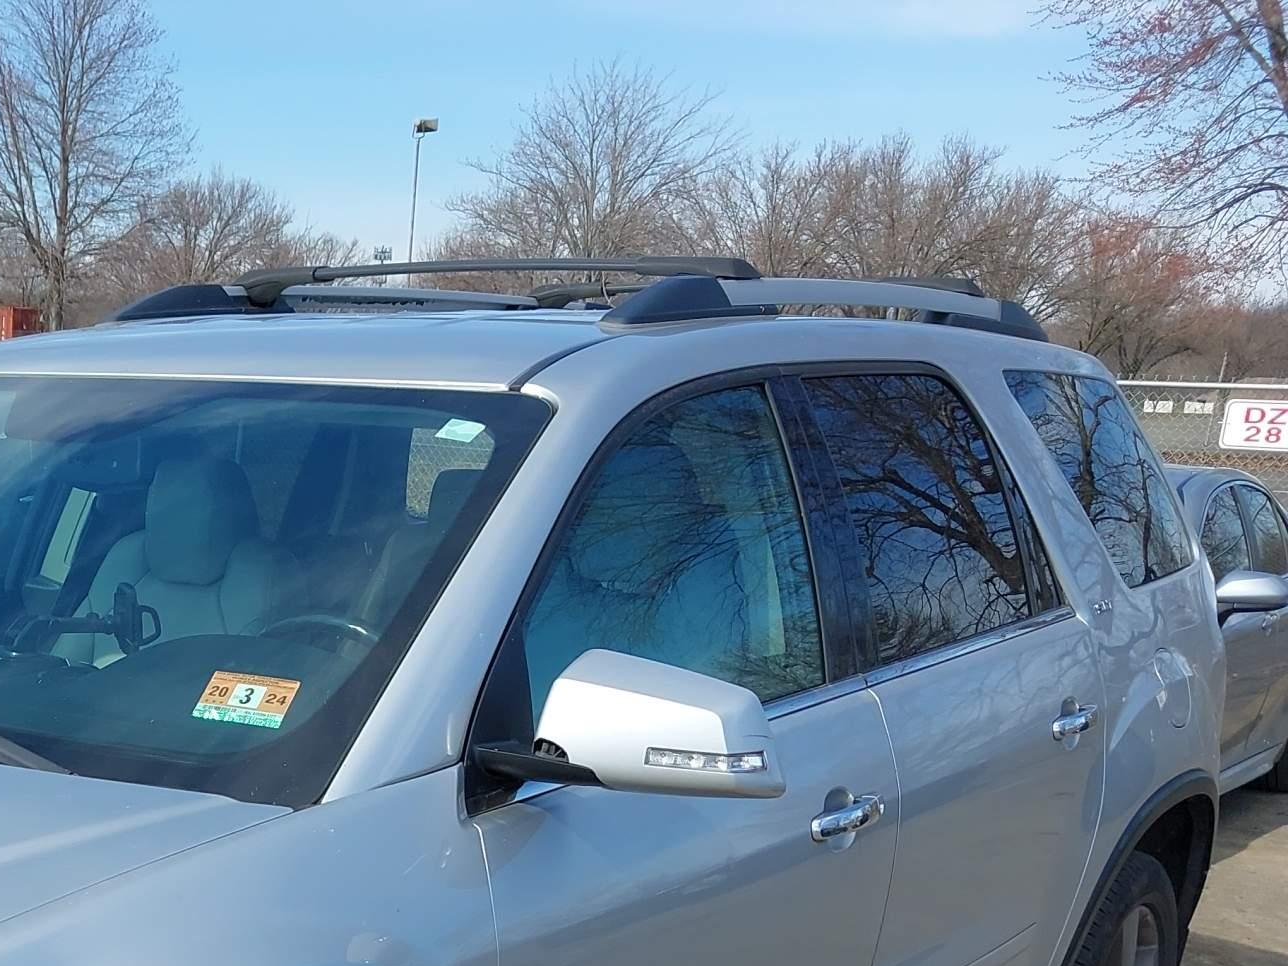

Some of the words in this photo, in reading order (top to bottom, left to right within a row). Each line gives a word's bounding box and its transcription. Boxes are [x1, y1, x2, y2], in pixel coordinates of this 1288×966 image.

[1243, 407, 1288, 424] DZ
[1243, 425, 1282, 444] 28
[208, 685, 229, 698] 20
[239, 687, 255, 705] 3
[265, 693, 288, 706] 24
